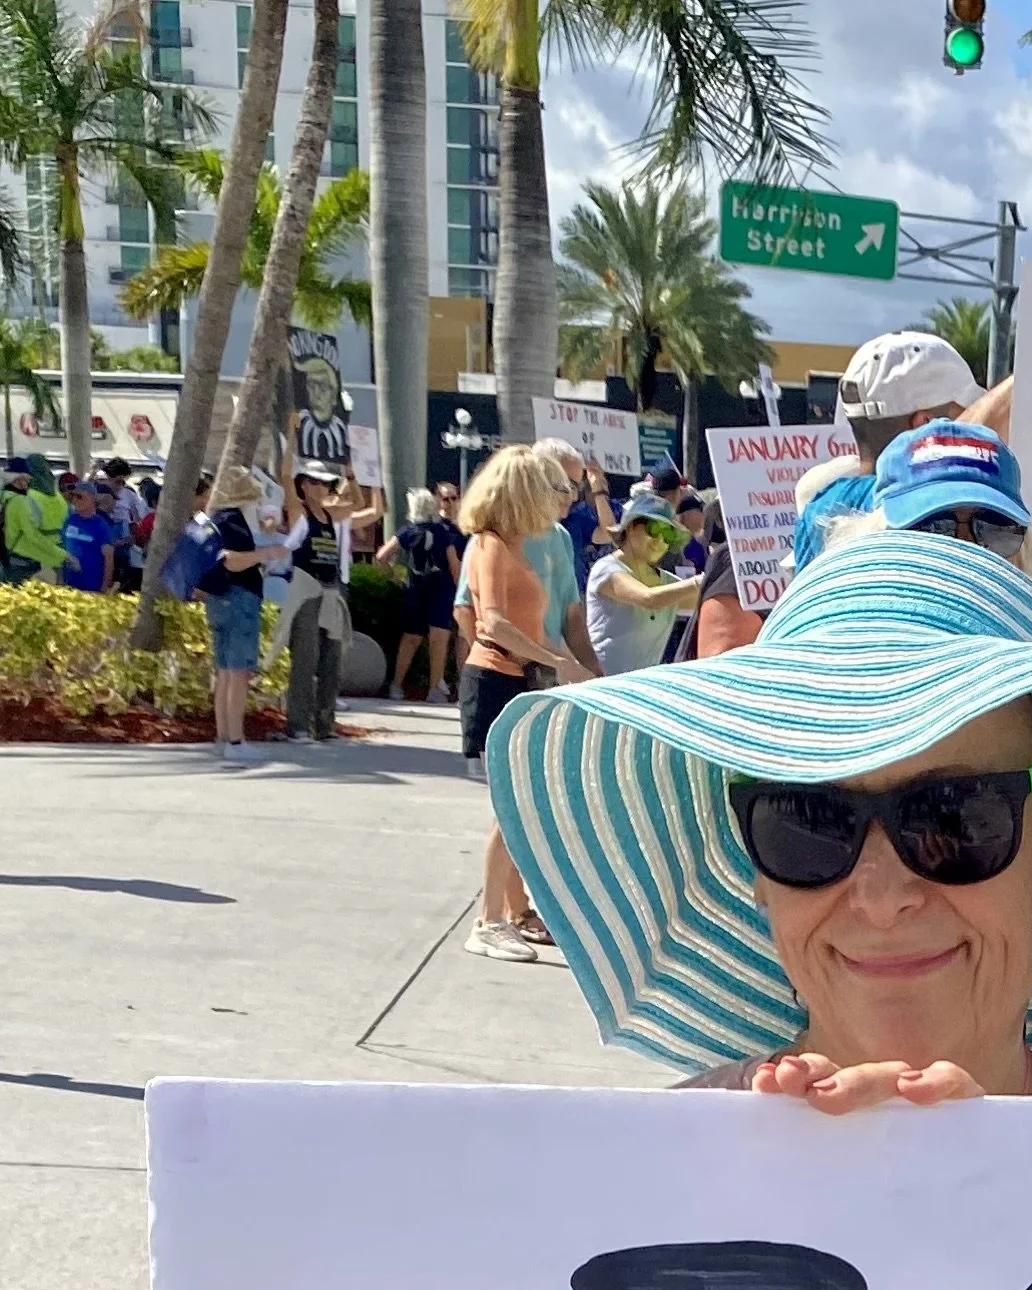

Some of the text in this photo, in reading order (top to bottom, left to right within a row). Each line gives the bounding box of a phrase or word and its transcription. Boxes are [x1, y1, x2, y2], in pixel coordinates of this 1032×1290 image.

[747, 229, 825, 259] Street
[550, 403, 578, 423] STOP
[727, 434, 819, 463] JANUARY
[727, 514, 769, 530] WHERE
[733, 536, 776, 554] TRUMP
[738, 560, 778, 576] ABOUT
